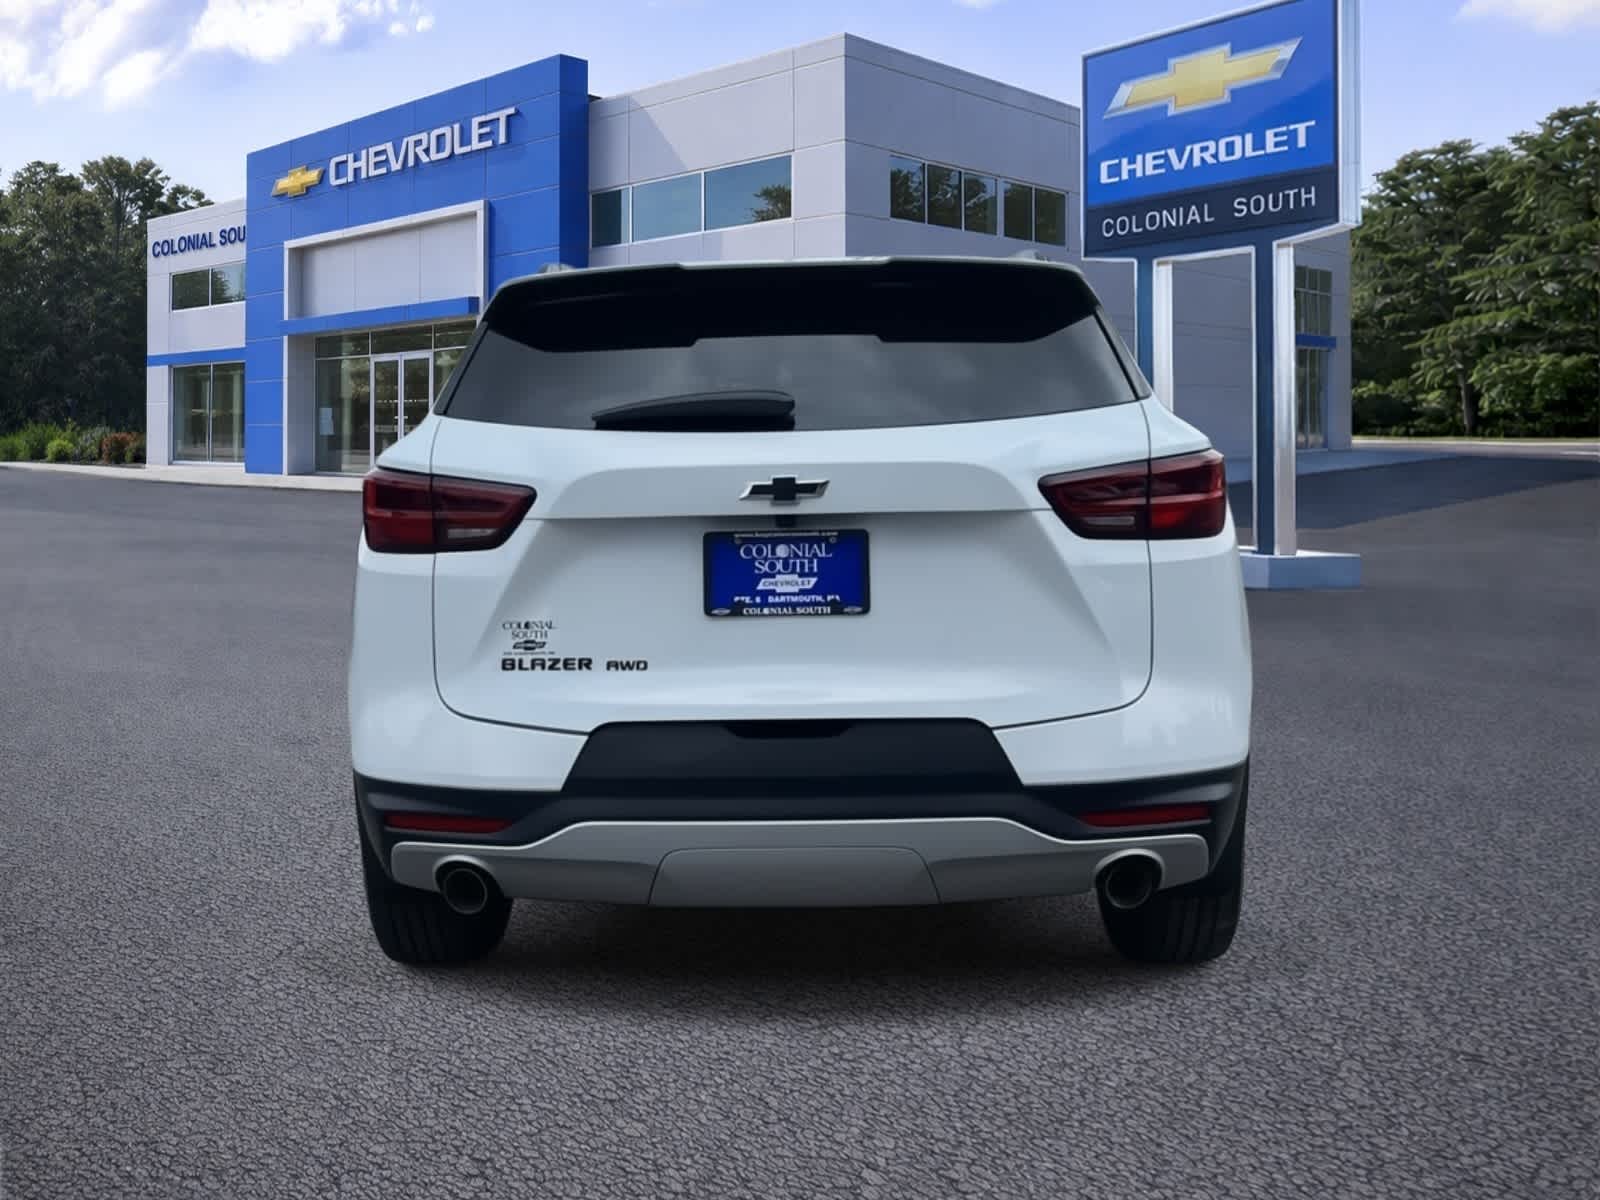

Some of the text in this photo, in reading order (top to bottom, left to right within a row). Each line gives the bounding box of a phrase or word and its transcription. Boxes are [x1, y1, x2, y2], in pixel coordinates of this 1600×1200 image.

[329, 106, 516, 187] CHEVROLET
[1099, 120, 1316, 184] CHEVROLET
[1102, 185, 1316, 237] COLONIAL SOUTH
[152, 231, 216, 258] COLONIAL
[739, 543, 833, 559] COLONIAL
[754, 559, 818, 574] SOUTH
[762, 579, 811, 587] CHEVROLET
[743, 606, 831, 616] COLONIAL SOUTH
[511, 630, 548, 640] SOUTH
[501, 657, 649, 671] BLAZER AWD
